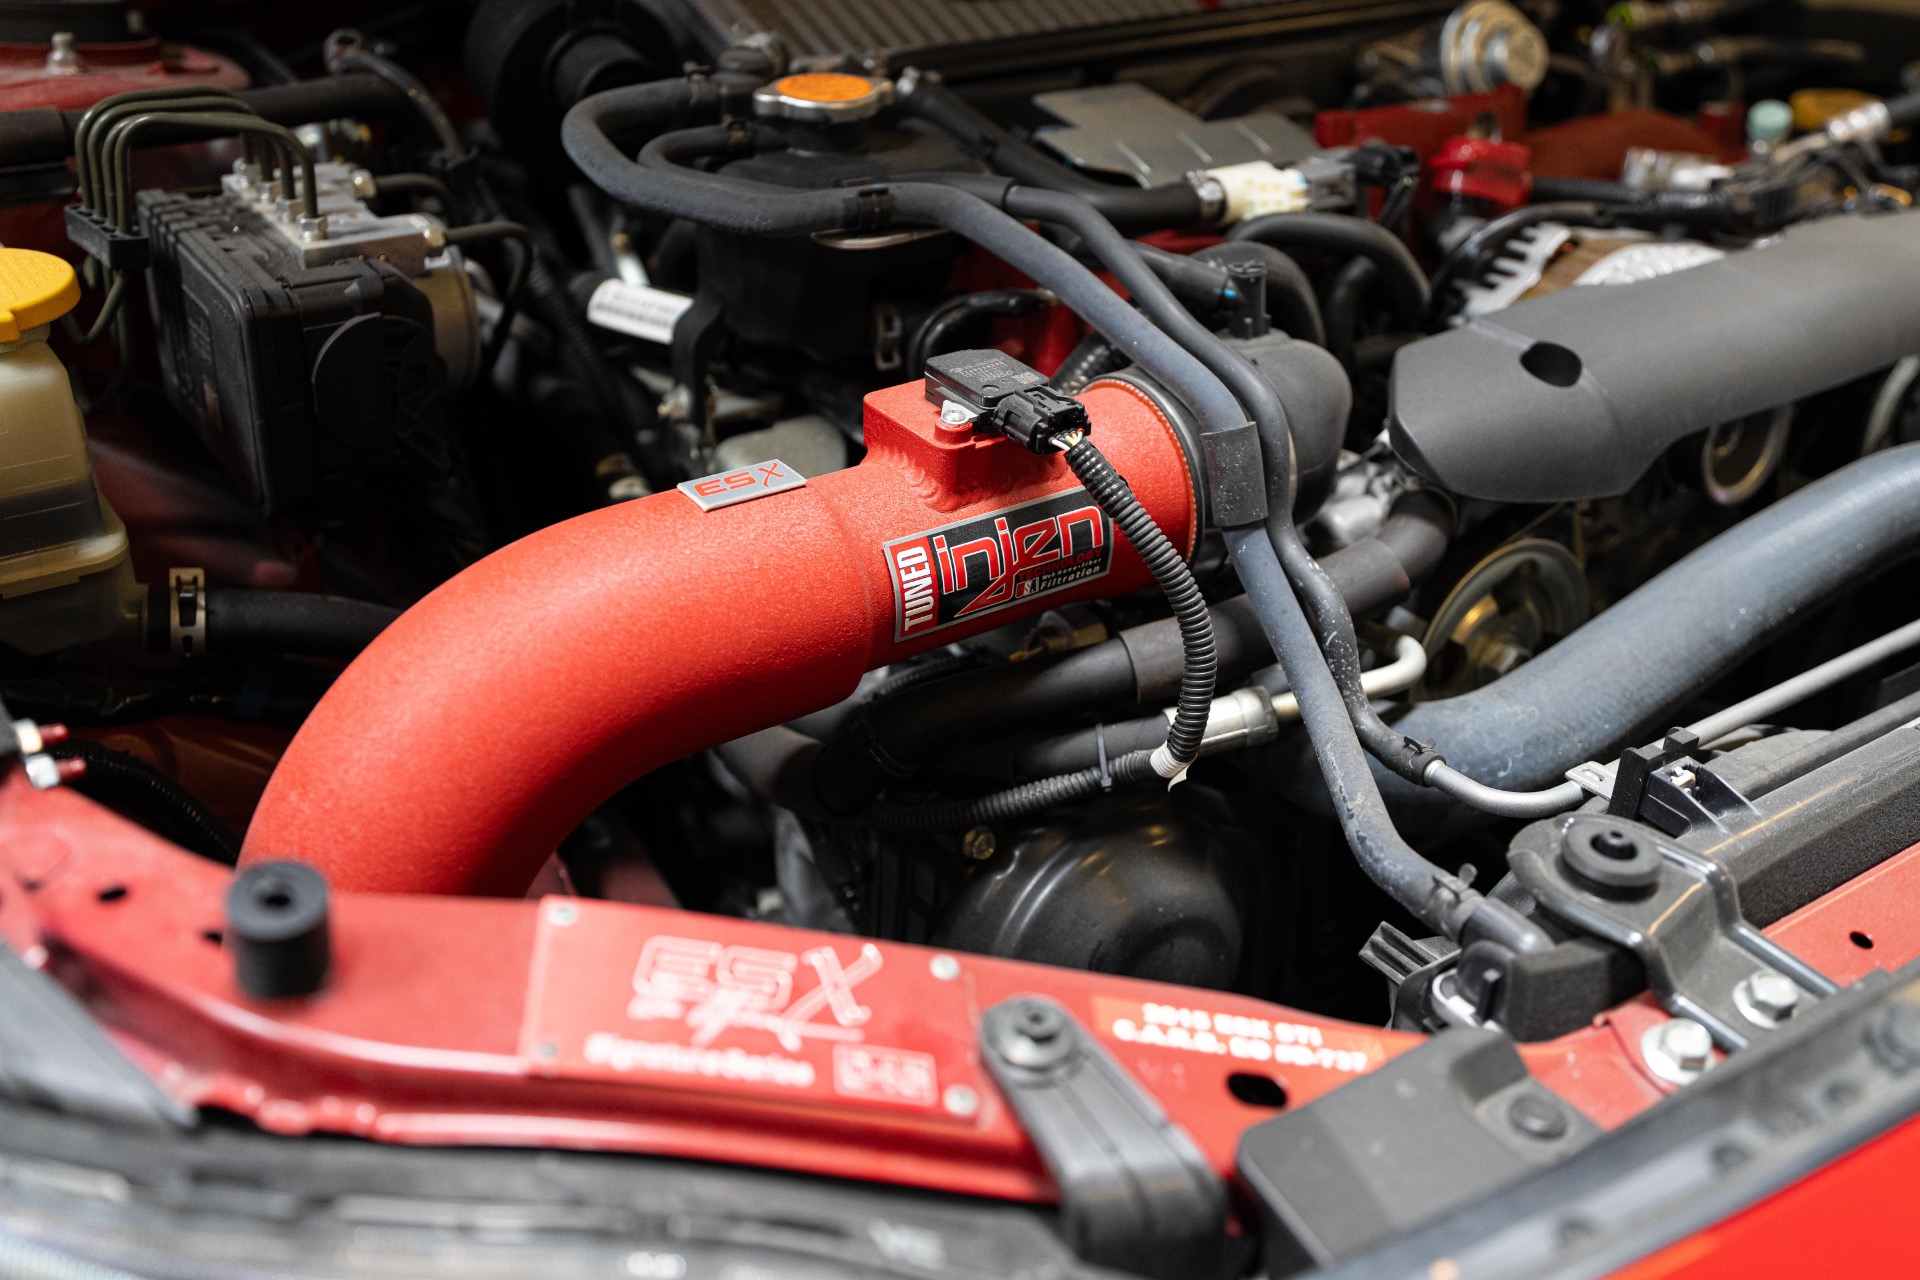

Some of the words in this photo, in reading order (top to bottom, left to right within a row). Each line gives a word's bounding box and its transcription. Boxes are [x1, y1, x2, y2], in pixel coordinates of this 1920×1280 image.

[694, 462, 784, 497] ESX
[896, 545, 935, 632] TUNED
[933, 506, 1104, 617] injen
[1018, 547, 1103, 580] TECHNOLOGY
[1040, 565, 1101, 590] Filtration
[632, 934, 884, 1027] ESX
